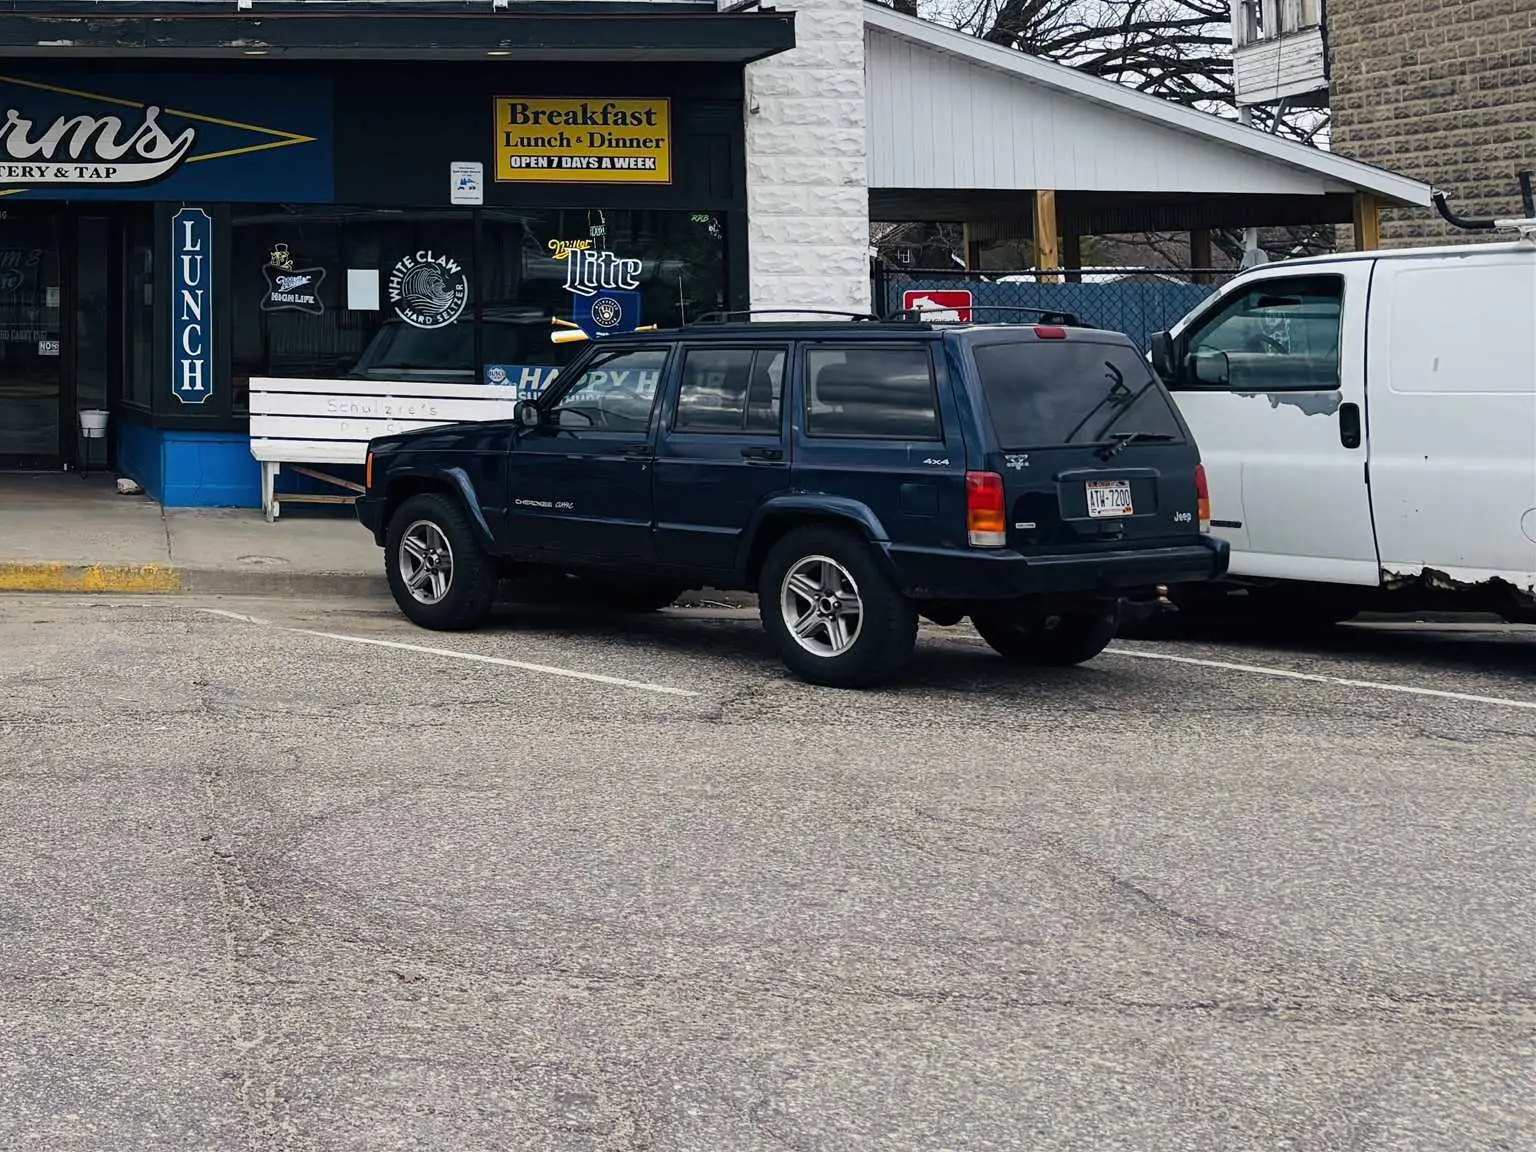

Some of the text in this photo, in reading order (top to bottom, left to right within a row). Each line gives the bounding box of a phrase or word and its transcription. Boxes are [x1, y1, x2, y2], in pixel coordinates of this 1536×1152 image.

[507, 103, 657, 126] Breakfast
[504, 131, 665, 149] Lunch & Dinner
[53, 165, 70, 178] &
[74, 166, 117, 179] TAP
[511, 156, 655, 169] OPEN 7 DAYS A WEEK
[548, 239, 592, 259] Miller
[389, 250, 461, 302] WHITE CLAW
[563, 248, 642, 296] Lite
[181, 221, 204, 390] LUNCH
[404, 284, 464, 324] HARD SELTZER
[1174, 511, 1192, 523] Jeep
